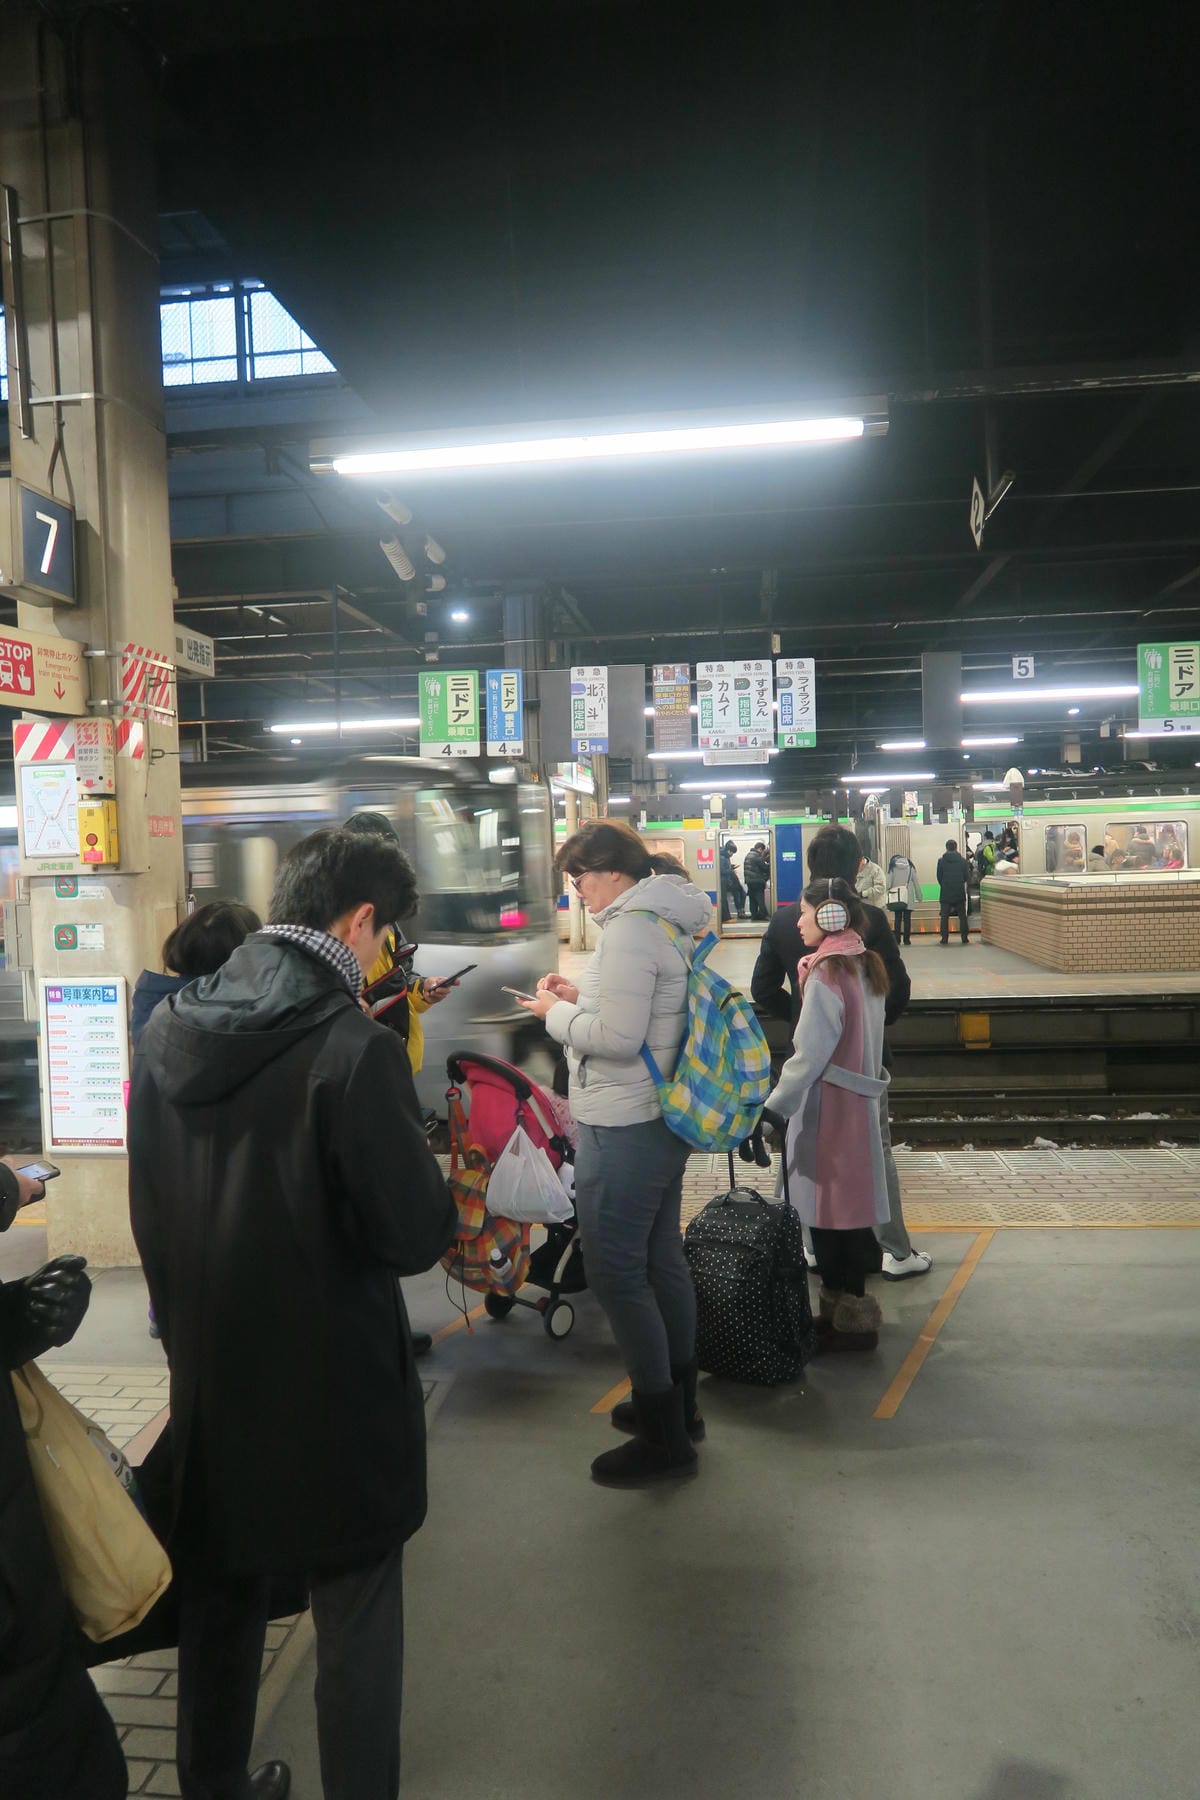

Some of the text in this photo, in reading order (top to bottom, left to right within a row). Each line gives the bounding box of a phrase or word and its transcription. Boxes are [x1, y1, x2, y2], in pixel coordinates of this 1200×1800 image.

[973, 491, 982, 536] 2
[35, 511, 58, 575] 7
[0, 642, 31, 661] STOP
[705, 664, 725, 672] 特急
[743, 662, 763, 671] 特急
[785, 661, 805, 670] 特急
[1017, 659, 1029, 677] 5
[1174, 649, 1195, 697] 三ドア
[451, 678, 470, 723] 三ドア
[503, 676, 516, 709] 二ドア
[718, 680, 730, 716] カムイ
[755, 678, 769, 717] すずらん
[798, 676, 810, 715] ライラック
[587, 684, 599, 720] 北斗
[781, 695, 793, 725] 自由席
[1163, 720, 1174, 732] 5
[499, 743, 507, 754] 4
[580, 742, 587, 751] 5
[713, 738, 720, 748] 4
[751, 737, 758, 746] 4
[787, 736, 794, 745] 4
[442, 744, 452, 756] 4
[63, 988, 102, 1000] 号車案内
